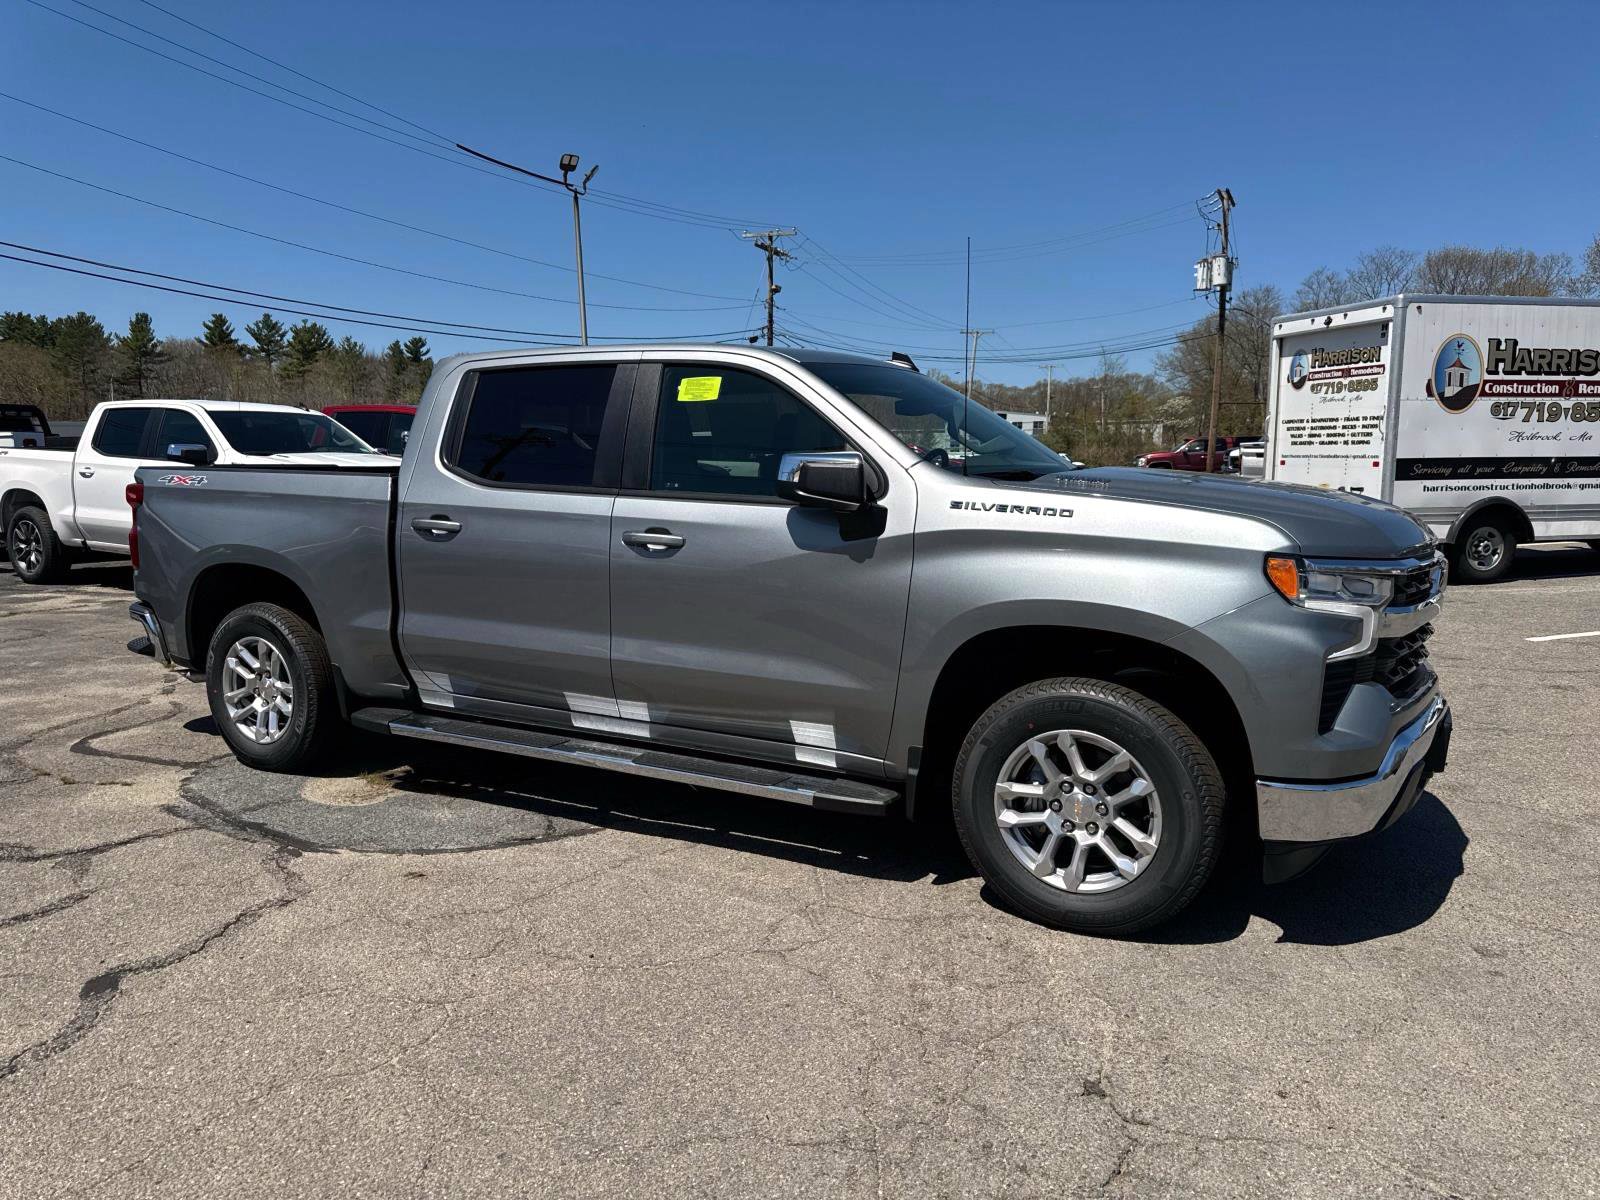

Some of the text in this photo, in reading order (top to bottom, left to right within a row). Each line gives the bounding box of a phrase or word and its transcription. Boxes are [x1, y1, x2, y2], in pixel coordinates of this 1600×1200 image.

[1310, 346, 1381, 369] HARRISON
[1486, 338, 1600, 376] HARRIS
[1309, 372, 1342, 380] Construction
[1350, 366, 1384, 376] Remodeling
[1484, 382, 1559, 394] Construction
[1563, 377, 1576, 400] &
[1490, 401, 1519, 417] 617
[1520, 401, 1562, 423] 719
[1409, 463, 1452, 476] Servicing
[1457, 464, 1472, 473] all
[1474, 466, 1495, 475] your
[1501, 462, 1548, 475] Carpentry
[950, 500, 1074, 518] SILVERADO
